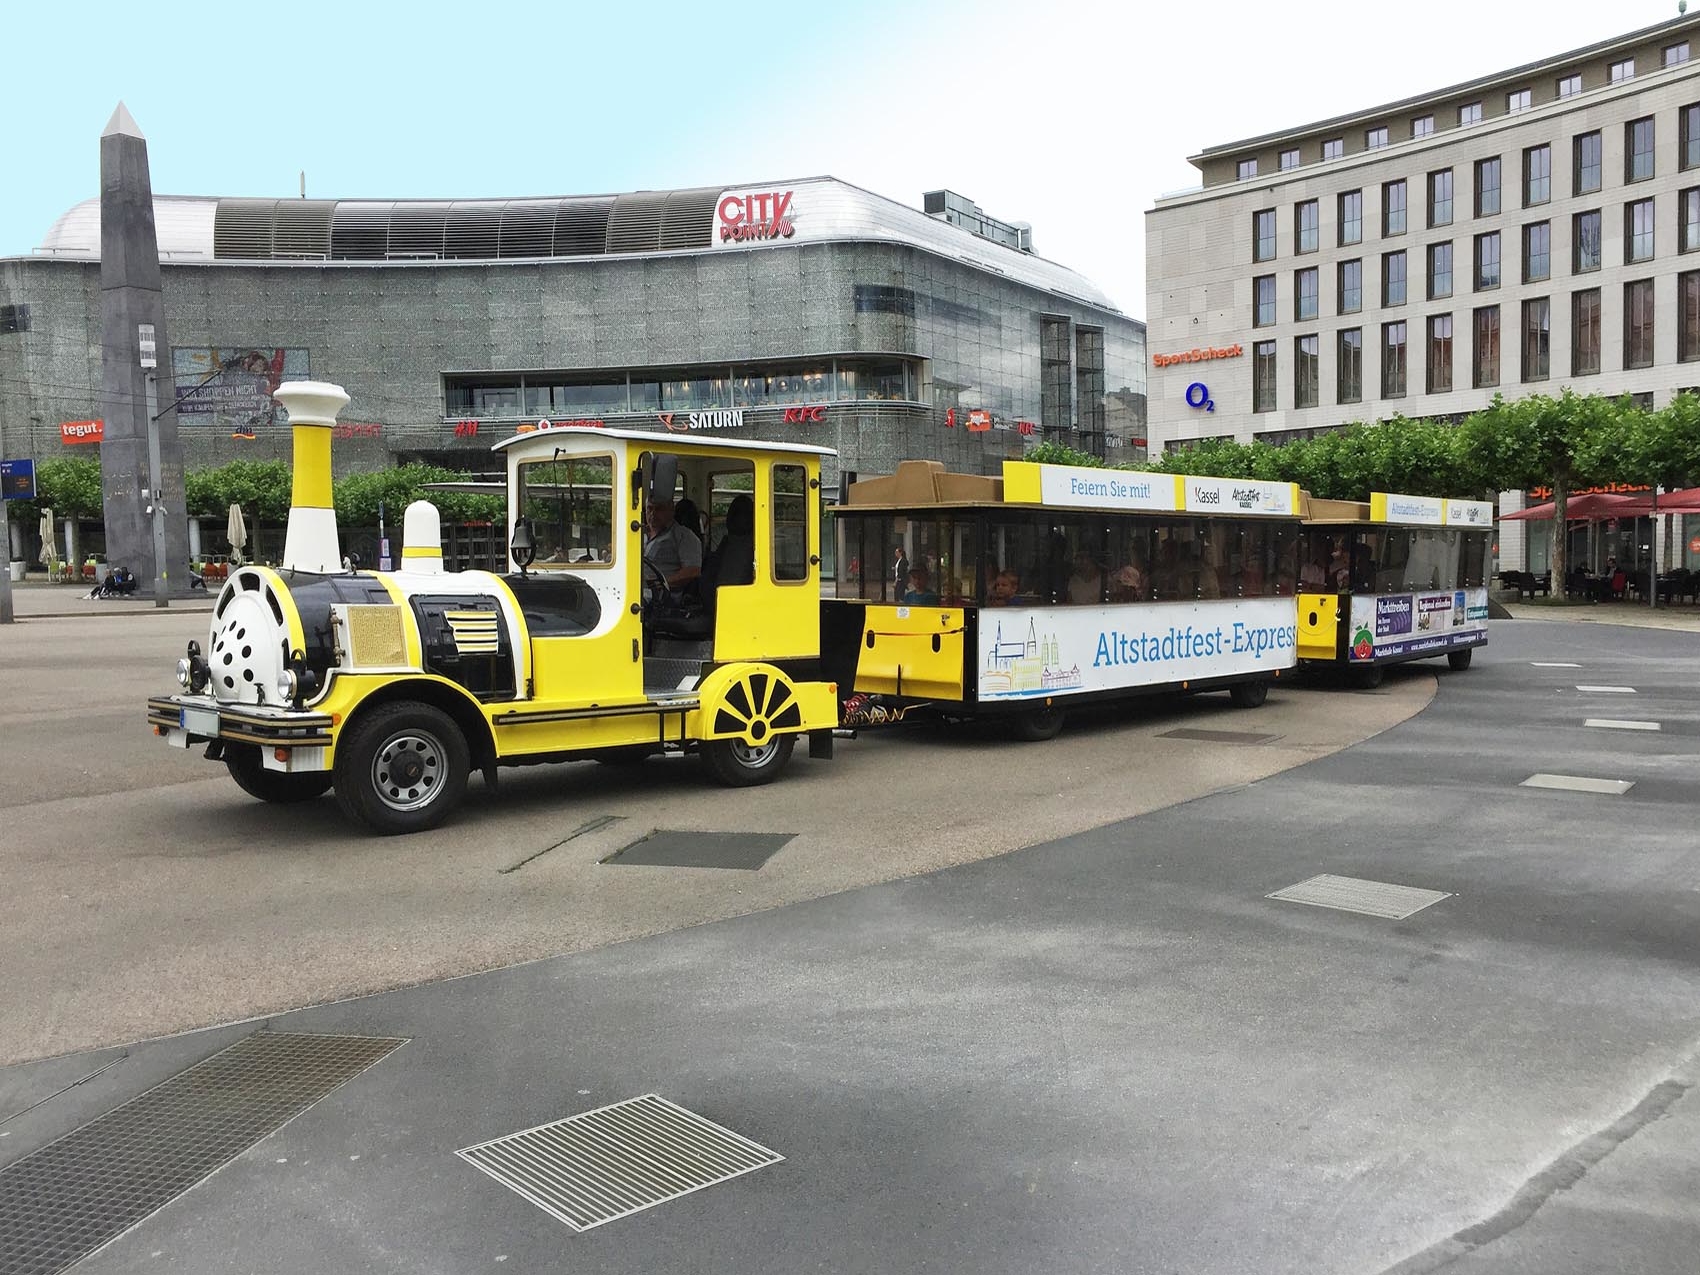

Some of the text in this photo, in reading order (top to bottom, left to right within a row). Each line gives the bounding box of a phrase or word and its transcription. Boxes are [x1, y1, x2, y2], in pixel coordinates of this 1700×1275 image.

[718, 191, 793, 236] CITY
[720, 222, 767, 240] POINT
[1153, 343, 1243, 367] SportScheck
[236, 384, 257, 396] NICHT
[689, 411, 743, 428] SATURN
[783, 406, 825, 423] KFC
[62, 423, 102, 436] tegut.
[1071, 478, 1150, 498] Feiern Sie mit!
[1195, 486, 1219, 504] Kassel
[1377, 600, 1410, 615] Markttreiben
